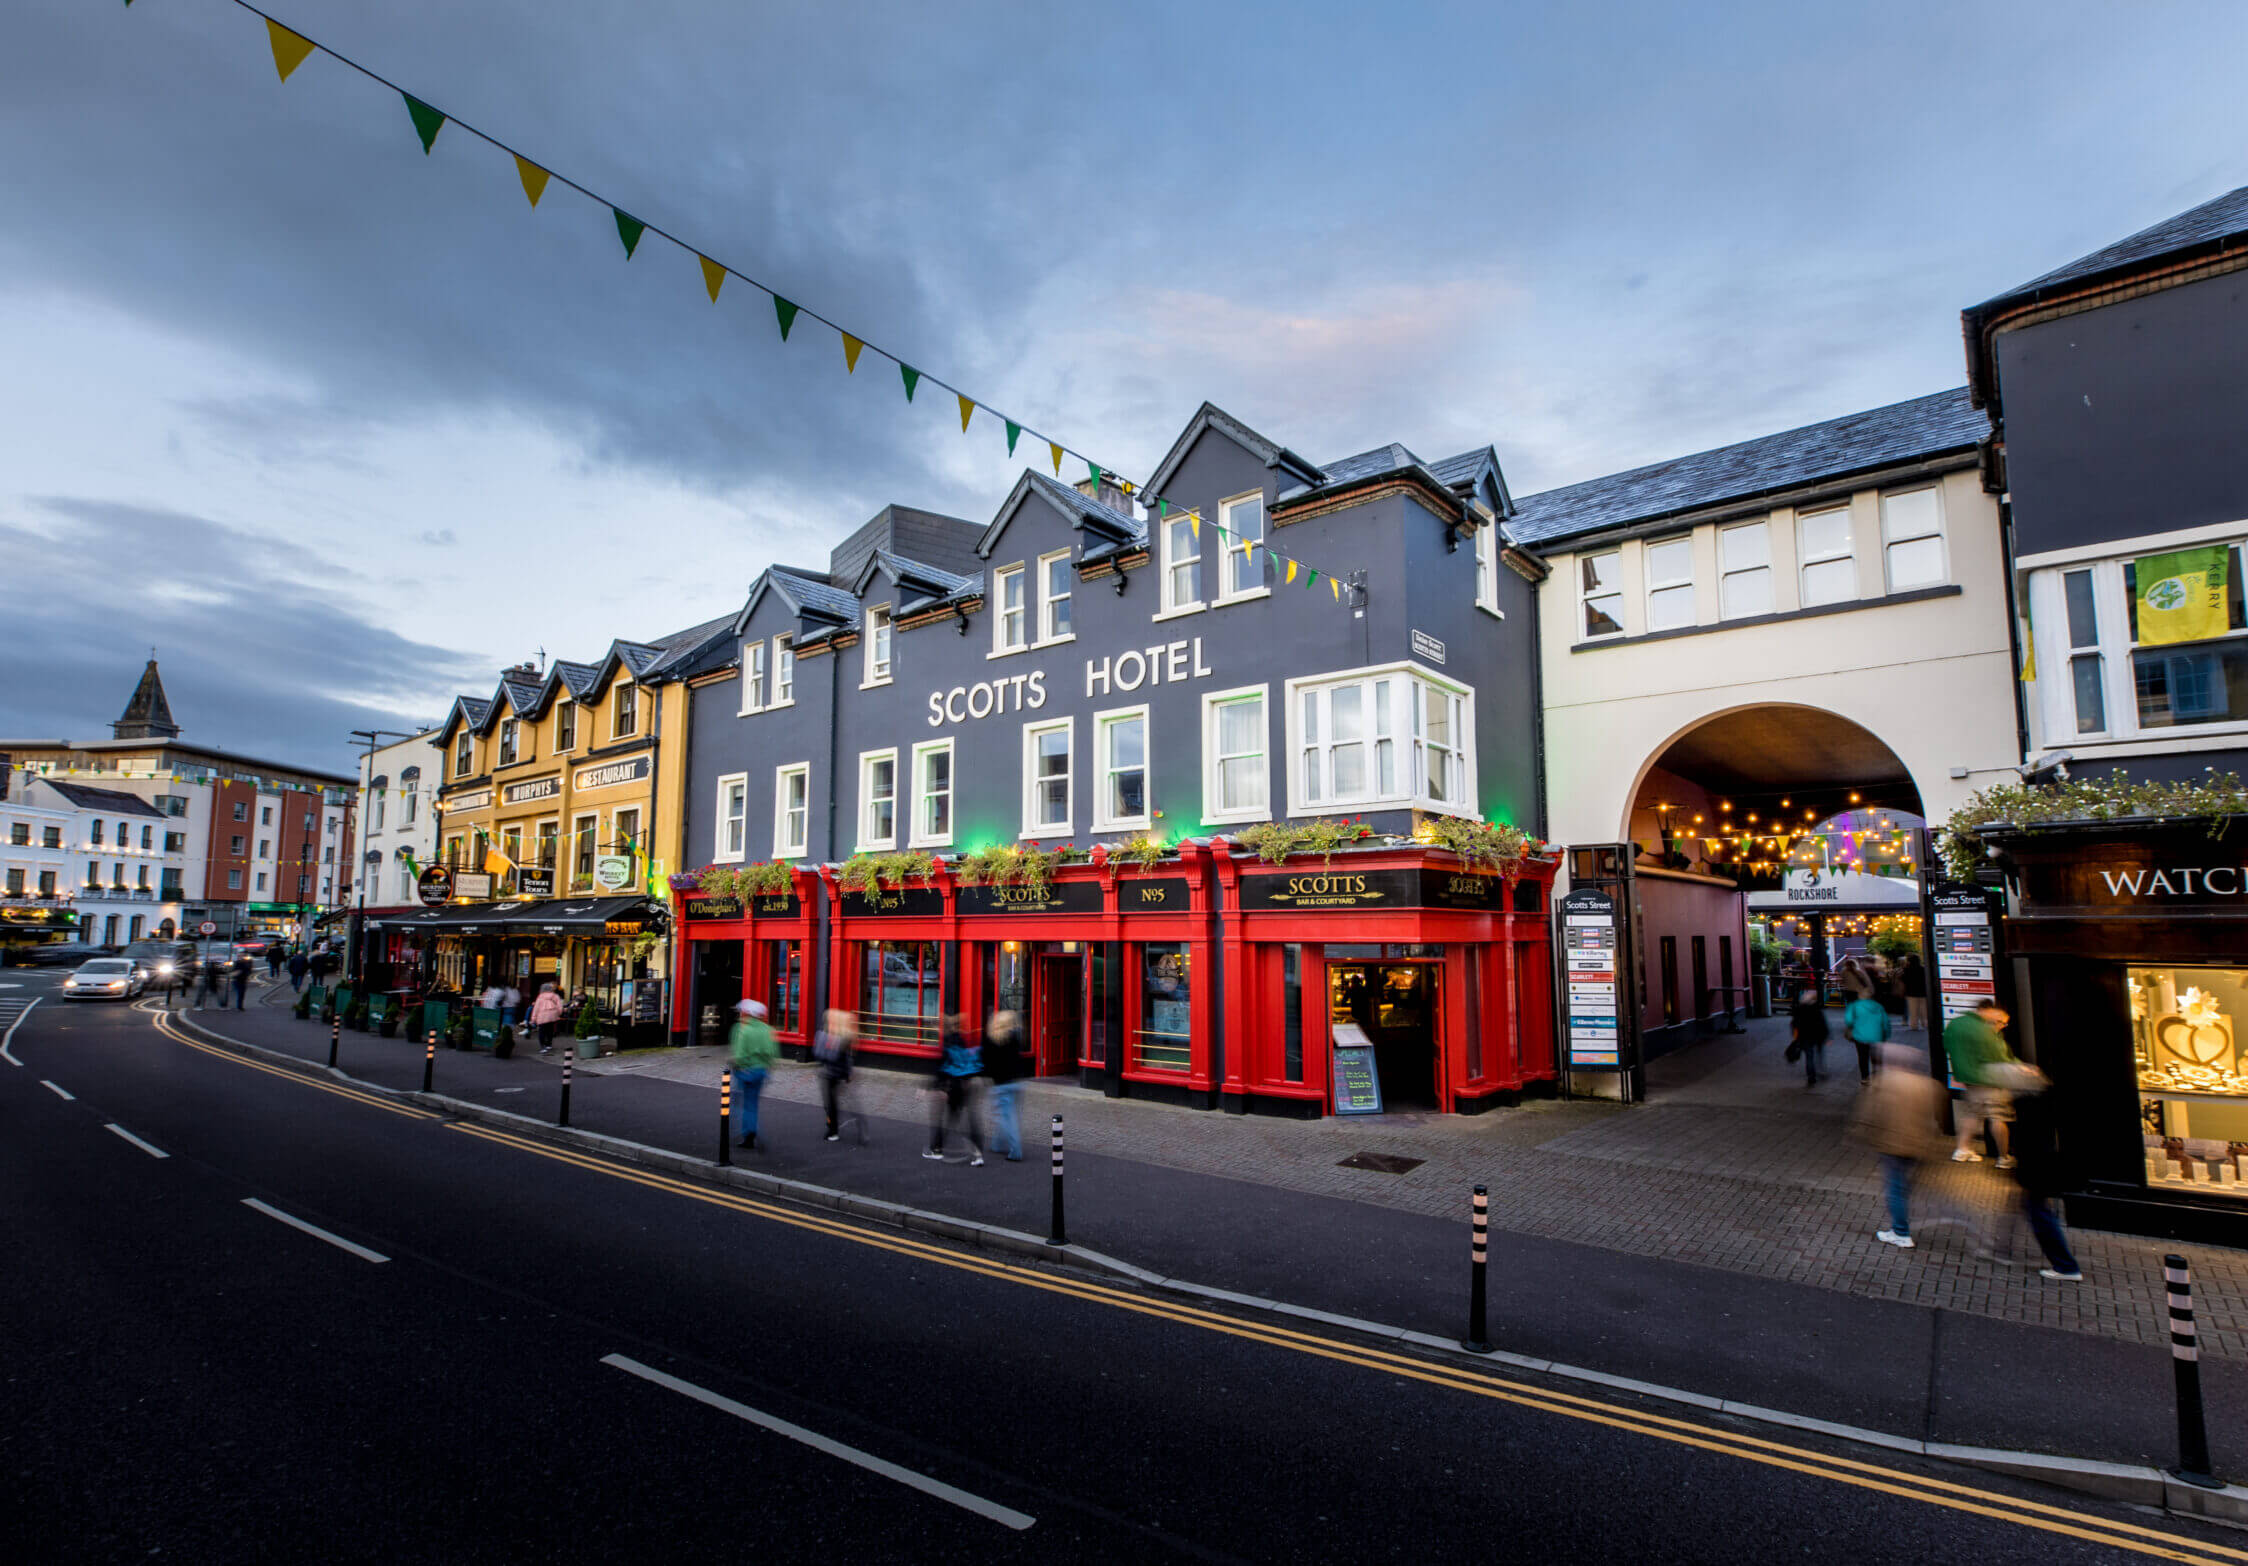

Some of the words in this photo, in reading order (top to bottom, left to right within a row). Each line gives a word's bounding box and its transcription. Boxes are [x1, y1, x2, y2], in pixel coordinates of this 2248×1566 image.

[2207, 563, 2221, 609] KERRY
[928, 670, 1047, 727] SCOTTS
[1086, 637, 1212, 697] HOTEL
[582, 763, 636, 788] RESTAURANT
[513, 780, 551, 801] MURPHYS
[1289, 875, 1367, 895] SCOTTS
[1788, 887, 1839, 901] ROCKSHORE
[1000, 887, 1050, 903] SCOTTS
[1317, 897, 1356, 905] COURTYARD
[1934, 896, 1959, 905] Scotts
[1960, 895, 1985, 905] Street
[1566, 900, 1588, 909] Scotts
[1589, 900, 1611, 909] Street
